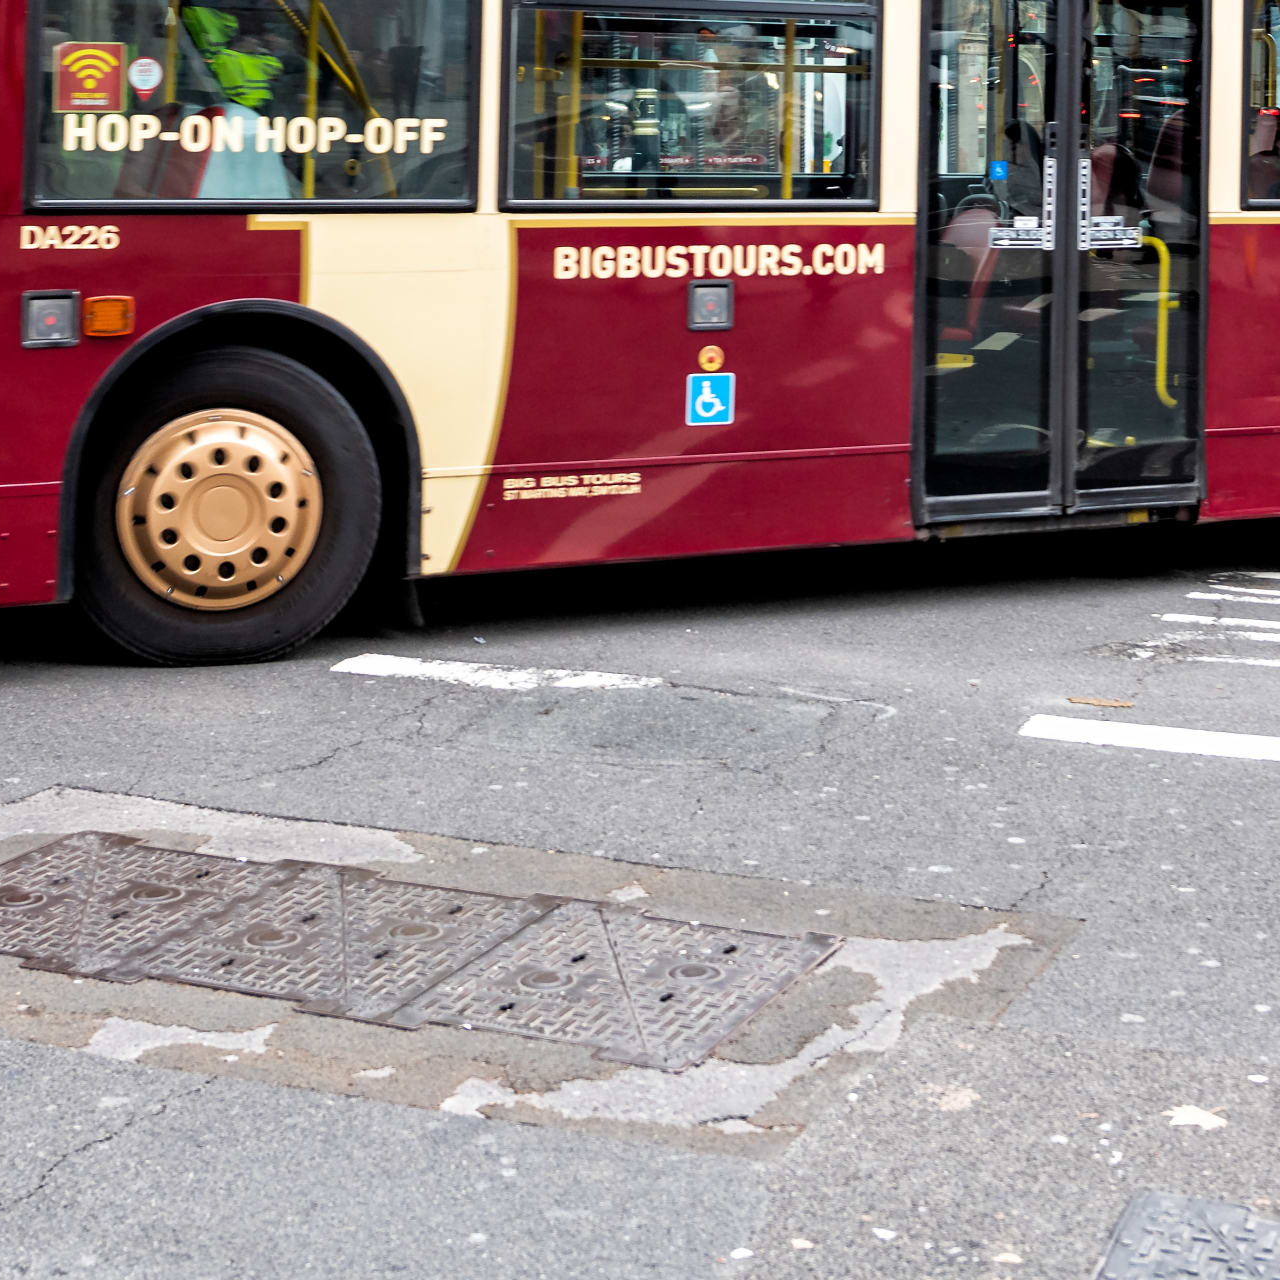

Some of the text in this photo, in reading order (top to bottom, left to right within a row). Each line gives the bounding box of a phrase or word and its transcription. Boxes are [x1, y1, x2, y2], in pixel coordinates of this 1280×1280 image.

[63, 113, 449, 155] HOP-ON HOP-OFF
[20, 225, 120, 250] DA226
[553, 243, 885, 280] BIGBUSTOURS.COM
[503, 472, 642, 489] BIG BUS TOURS
